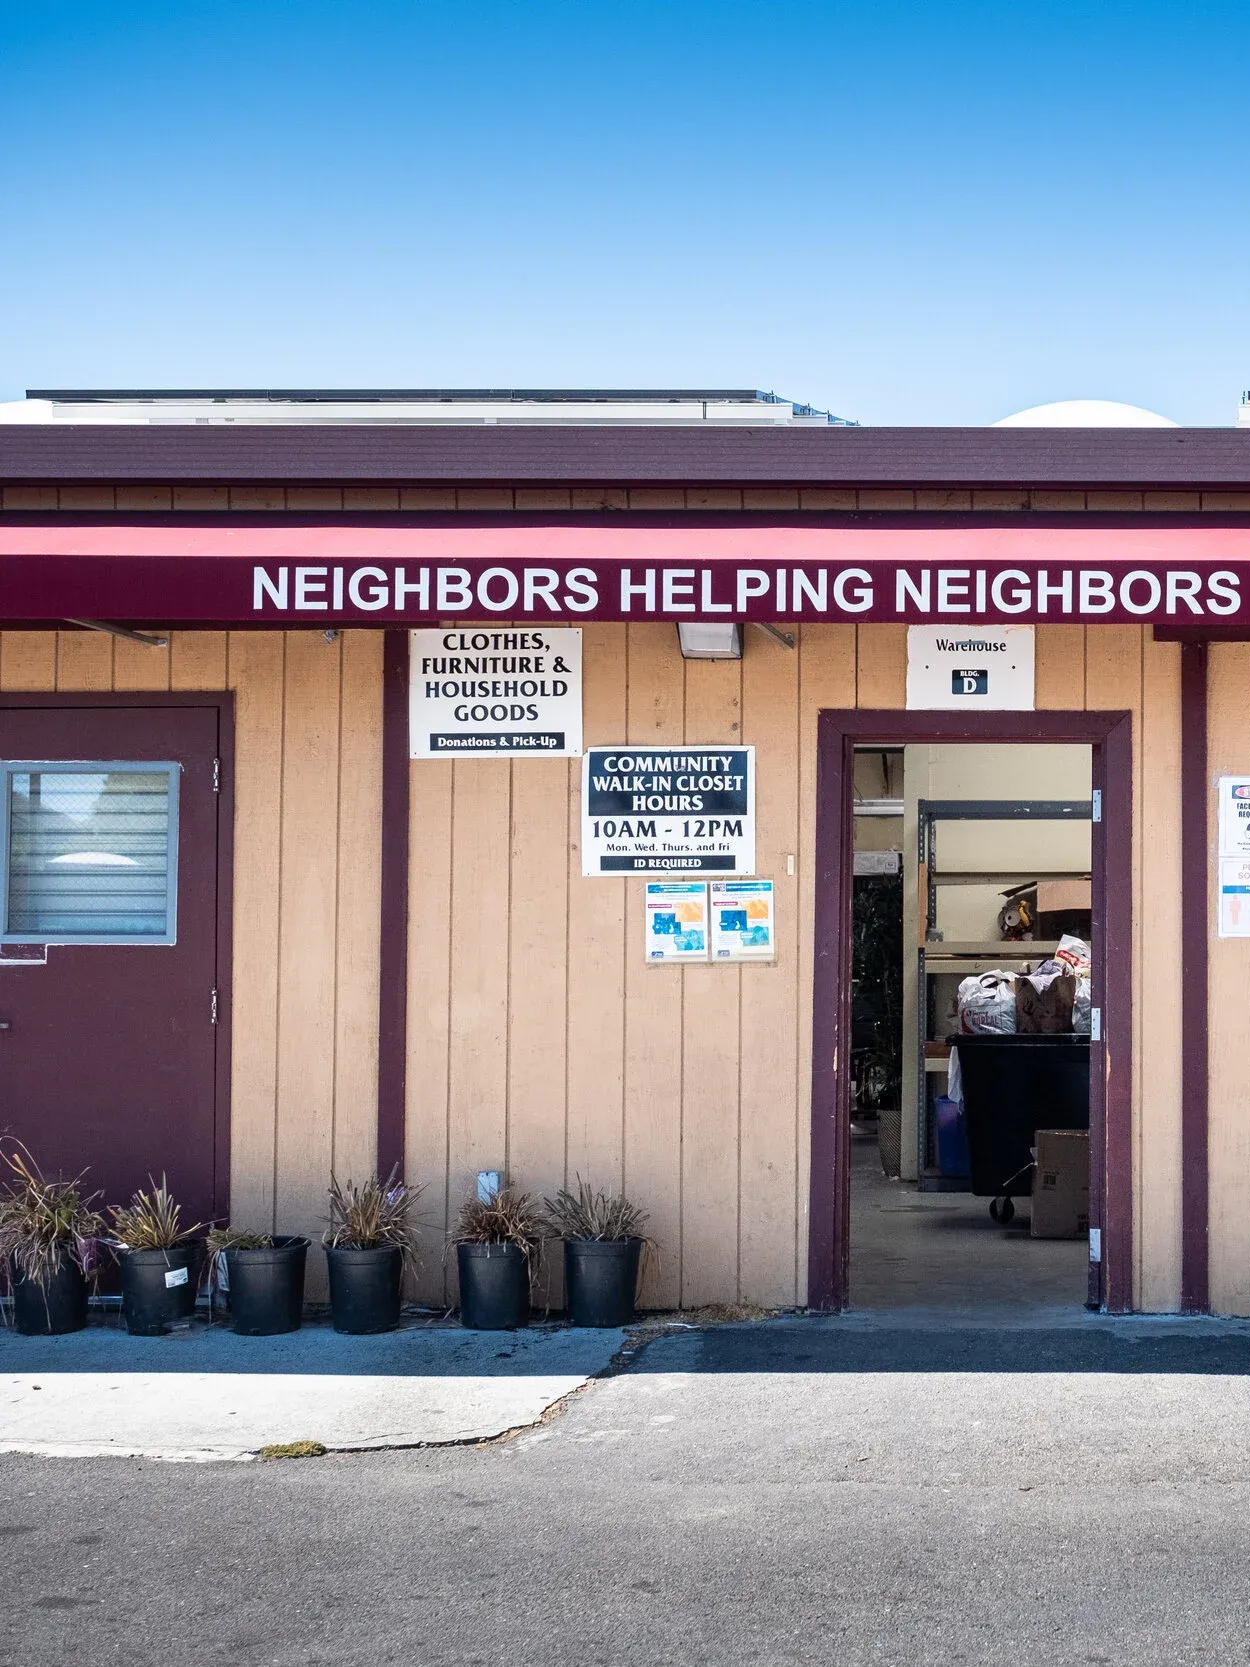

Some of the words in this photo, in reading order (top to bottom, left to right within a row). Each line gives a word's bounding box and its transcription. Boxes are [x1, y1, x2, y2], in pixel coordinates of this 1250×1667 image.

[252, 566, 599, 612] NEIGHBORS
[620, 568, 874, 613] HELPING
[896, 569, 1242, 615] NEIGHBORS
[442, 633, 550, 652] CLOTHES,
[936, 638, 1007, 652] Warehouse
[421, 657, 545, 674] FURNITURE
[552, 656, 572, 673] &
[425, 680, 568, 698] HOUSEHOLD
[963, 677, 977, 693] D
[454, 704, 539, 721] GOODS
[437, 737, 497, 747] Donations
[499, 736, 510, 747] &
[512, 735, 557, 748] Pick-Up
[603, 756, 733, 772] COMMUNITY
[592, 776, 671, 792] WALK-IN
[676, 775, 744, 791] CLOSET
[632, 795, 704, 811] HOURS
[593, 820, 657, 838] 10AM
[682, 819, 744, 838] 12PM
[606, 843, 631, 852] Mon.
[634, 843, 658, 852] Wed.
[662, 843, 693, 852] Thurs.
[696, 843, 715, 851] and
[718, 843, 730, 851] Fri
[634, 859, 647, 868] ID
[648, 858, 702, 869] REQUIRED
